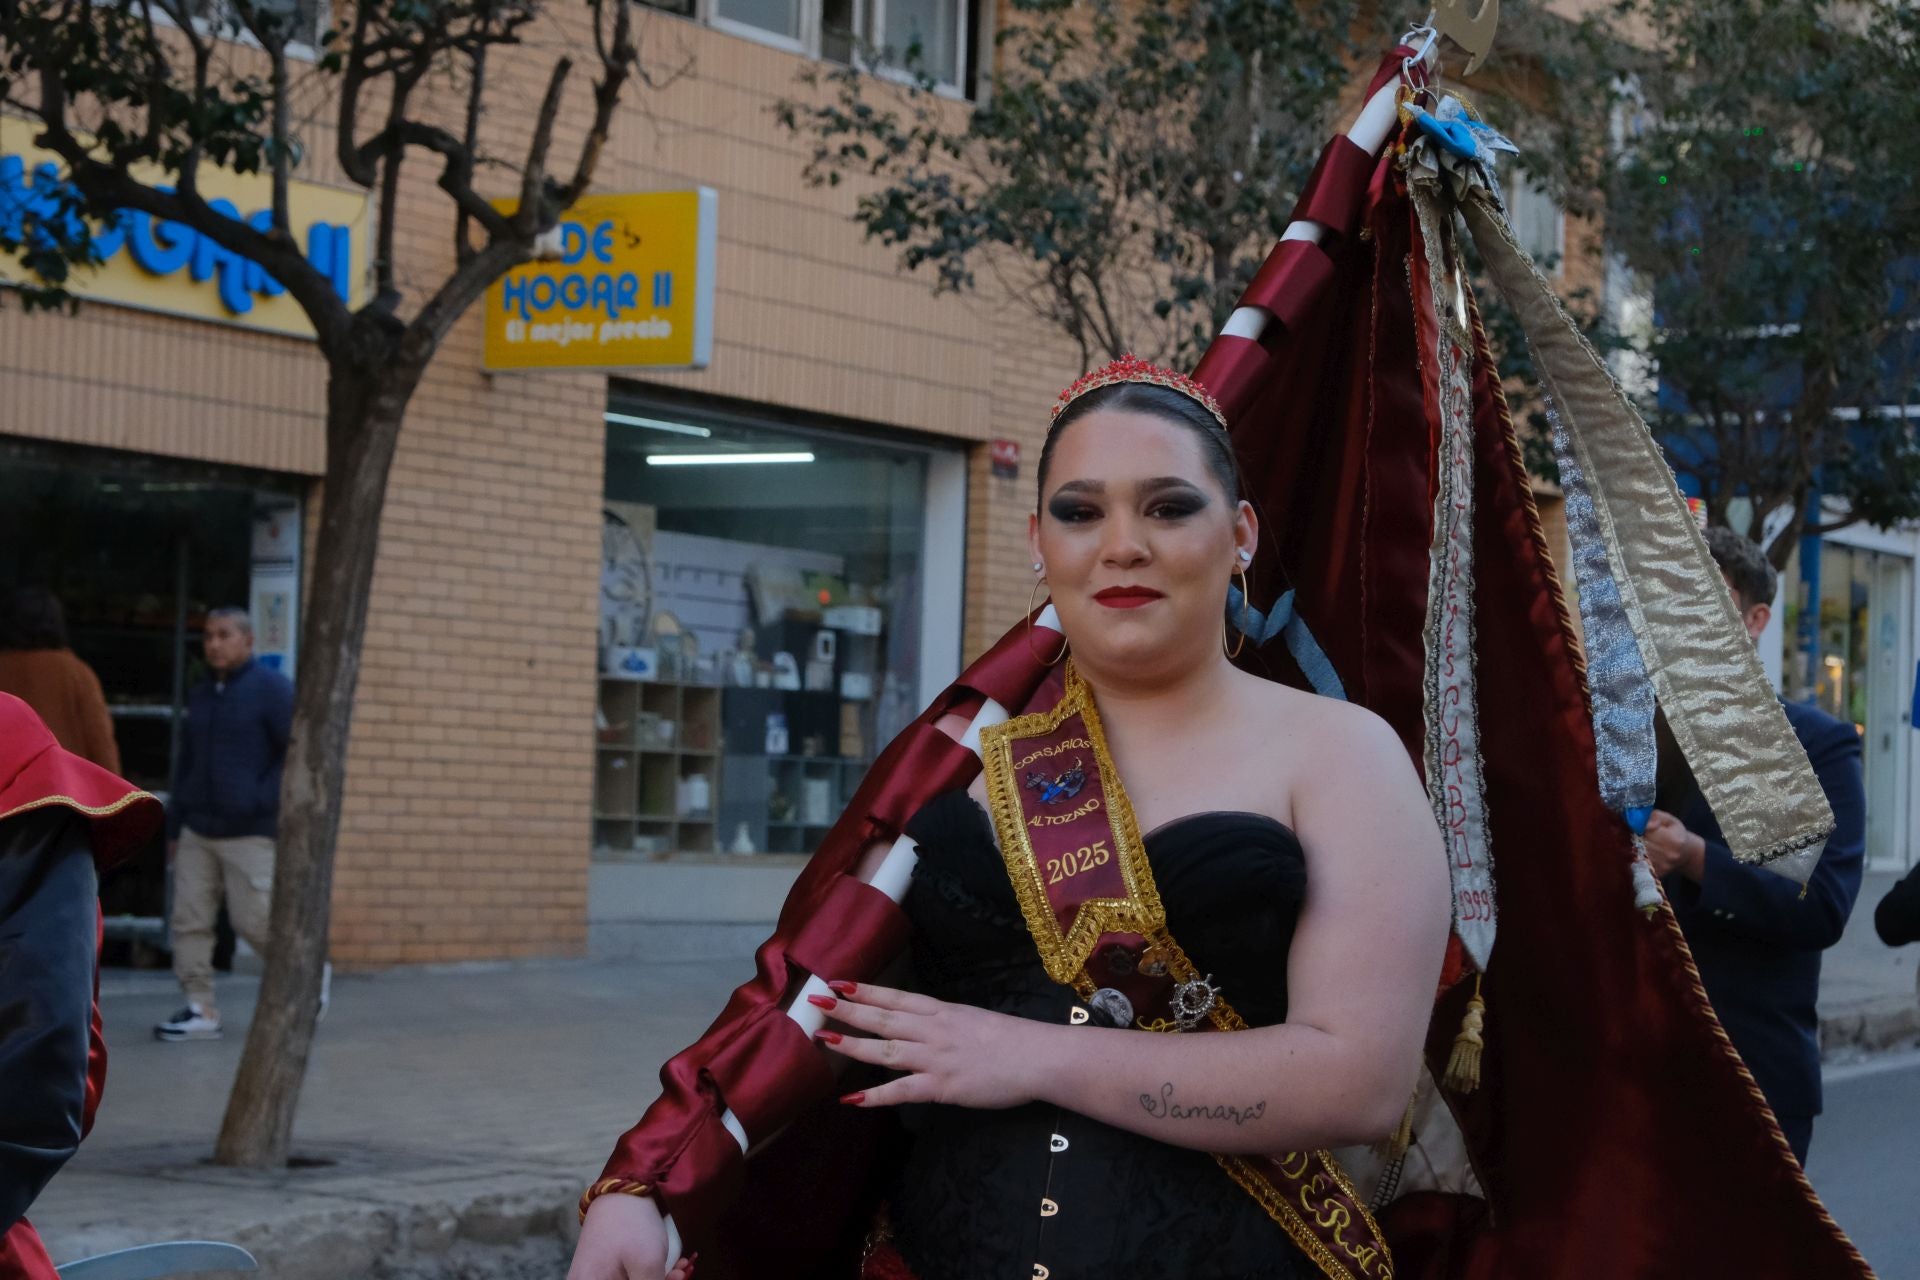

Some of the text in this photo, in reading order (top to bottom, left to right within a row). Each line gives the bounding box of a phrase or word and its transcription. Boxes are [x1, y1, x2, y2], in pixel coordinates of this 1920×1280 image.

[561, 220, 615, 265] DE
[503, 271, 673, 322] HOGAR II
[530, 316, 596, 347] mejor
[599, 315, 673, 345] precio
[1014, 737, 1092, 770] CORSARIOS
[1027, 798, 1100, 827] ALTOZANO
[1046, 840, 1110, 885] 2025
[1459, 889, 1491, 922] 1999
[1150, 1082, 1262, 1125] Samara
